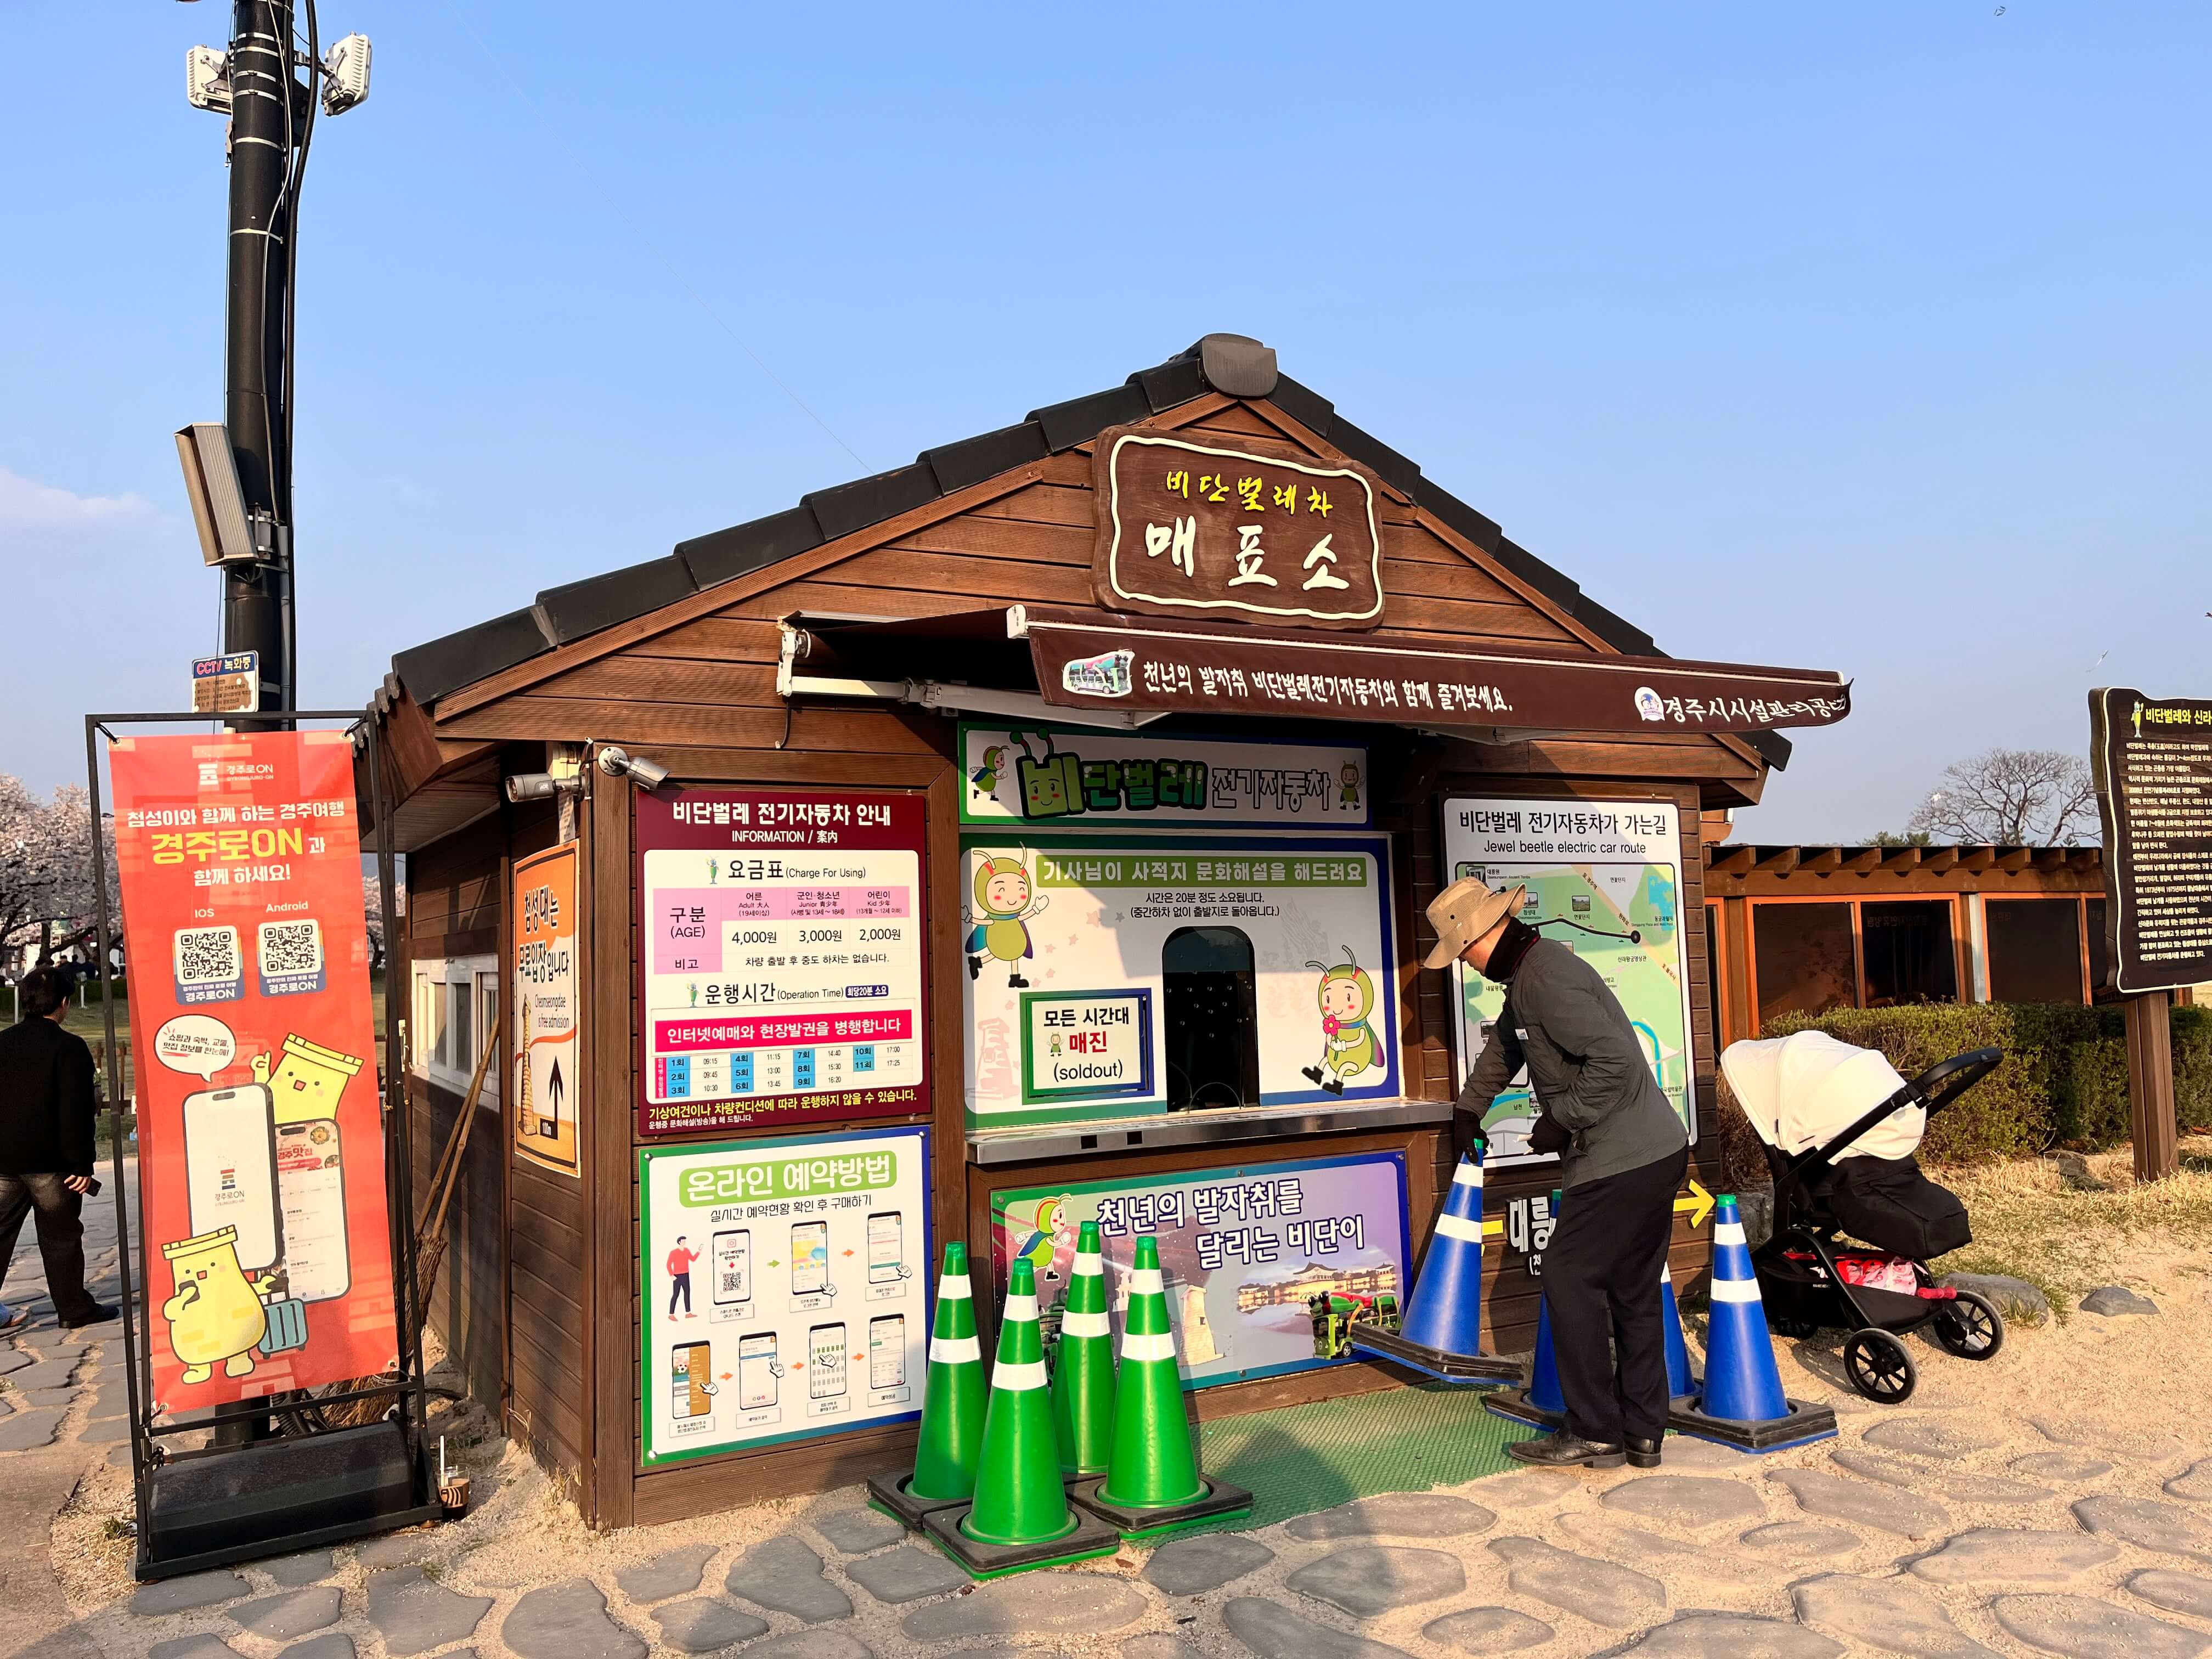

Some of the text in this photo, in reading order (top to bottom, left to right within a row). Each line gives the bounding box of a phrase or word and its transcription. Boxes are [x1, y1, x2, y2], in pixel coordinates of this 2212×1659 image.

[1145, 515, 1350, 591] 매표소
[196, 657, 251, 675] CCTV 녹화중
[1143, 661, 1513, 712] 천년의 발자취 비단벌레전기자동차와 함께 즐겨보세요.
[2146, 708, 2191, 724] 비단벌레와
[227, 763, 273, 774] 경주로ON
[1211, 766, 1331, 813] 전기자동차
[127, 801, 345, 828] 첨성이와 함께 하는 경주여행
[673, 802, 890, 826] 비단벌레 전기자동차 안내
[1460, 811, 1666, 835] 비단벌레 전기자동차가 가는길
[732, 830, 804, 842] INFORMATION
[151, 827, 325, 865] 경주로ON 과
[1484, 840, 1646, 853] Jewel beetle electric car route
[194, 864, 290, 887] 함께 하세요!
[729, 860, 866, 880] 요금표 (Charge For Using)
[1043, 861, 1363, 881] 기사님이 사적지 문화해설을 해드려요
[746, 892, 763, 901] 어른
[867, 891, 890, 899] 어린이
[1146, 892, 1265, 903] 시간은 20분 정도 소요됩니다.
[266, 901, 308, 913] Android
[525, 886, 558, 933] 첨성대는
[670, 907, 706, 923] 구분
[1130, 907, 1170, 918] (중간하차
[1173, 906, 1191, 917] 없이
[1193, 906, 1229, 917] 출발지로
[670, 926, 705, 939] (AGE)
[732, 932, 777, 945] 4,000원
[799, 930, 842, 944] 3,000원
[859, 928, 901, 942] 2,000원
[520, 942, 569, 983] 무료입장입니다
[675, 958, 699, 970] 비고
[746, 953, 889, 967] 차량 출발 후 중도 하차는 없습니다.
[185, 989, 235, 1002] 경주로ON
[269, 981, 317, 994] 경주로ON
[705, 983, 775, 1005] 운행시간
[777, 989, 819, 1001] (Operation
[822, 988, 843, 998] Time)
[874, 986, 888, 995] 소요
[535, 994, 566, 1011] Cheomseongdae
[549, 1013, 569, 1029] admission
[1043, 1006, 1129, 1028] 모든 시간대
[667, 1017, 901, 1044] 인터넷예매와 현장발권을 병행합니다
[168, 1034, 210, 1046] 쇼핑과 숙박,
[1069, 1031, 1108, 1054] 매진
[855, 1060, 871, 1069] 11회
[1053, 1058, 1124, 1082] (soldout)
[649, 1089, 917, 1120] 기상여건이나 차량컨디션에 따라 운행하지 않을 수 있습니다.
[727, 1114, 753, 1123] 드립니다.
[541, 1121, 551, 1136] 100m
[687, 1154, 890, 1201] 온라인 예약방법
[215, 1190, 245, 1201] 경주로ON
[710, 1194, 872, 1223] 실시간 예약현황 확인 후 구매하기
[1097, 1177, 1302, 1237] 천년의 발자취를
[1509, 1197, 1549, 1252] 대릉
[1196, 1214, 1364, 1271] 달리는 비단이
